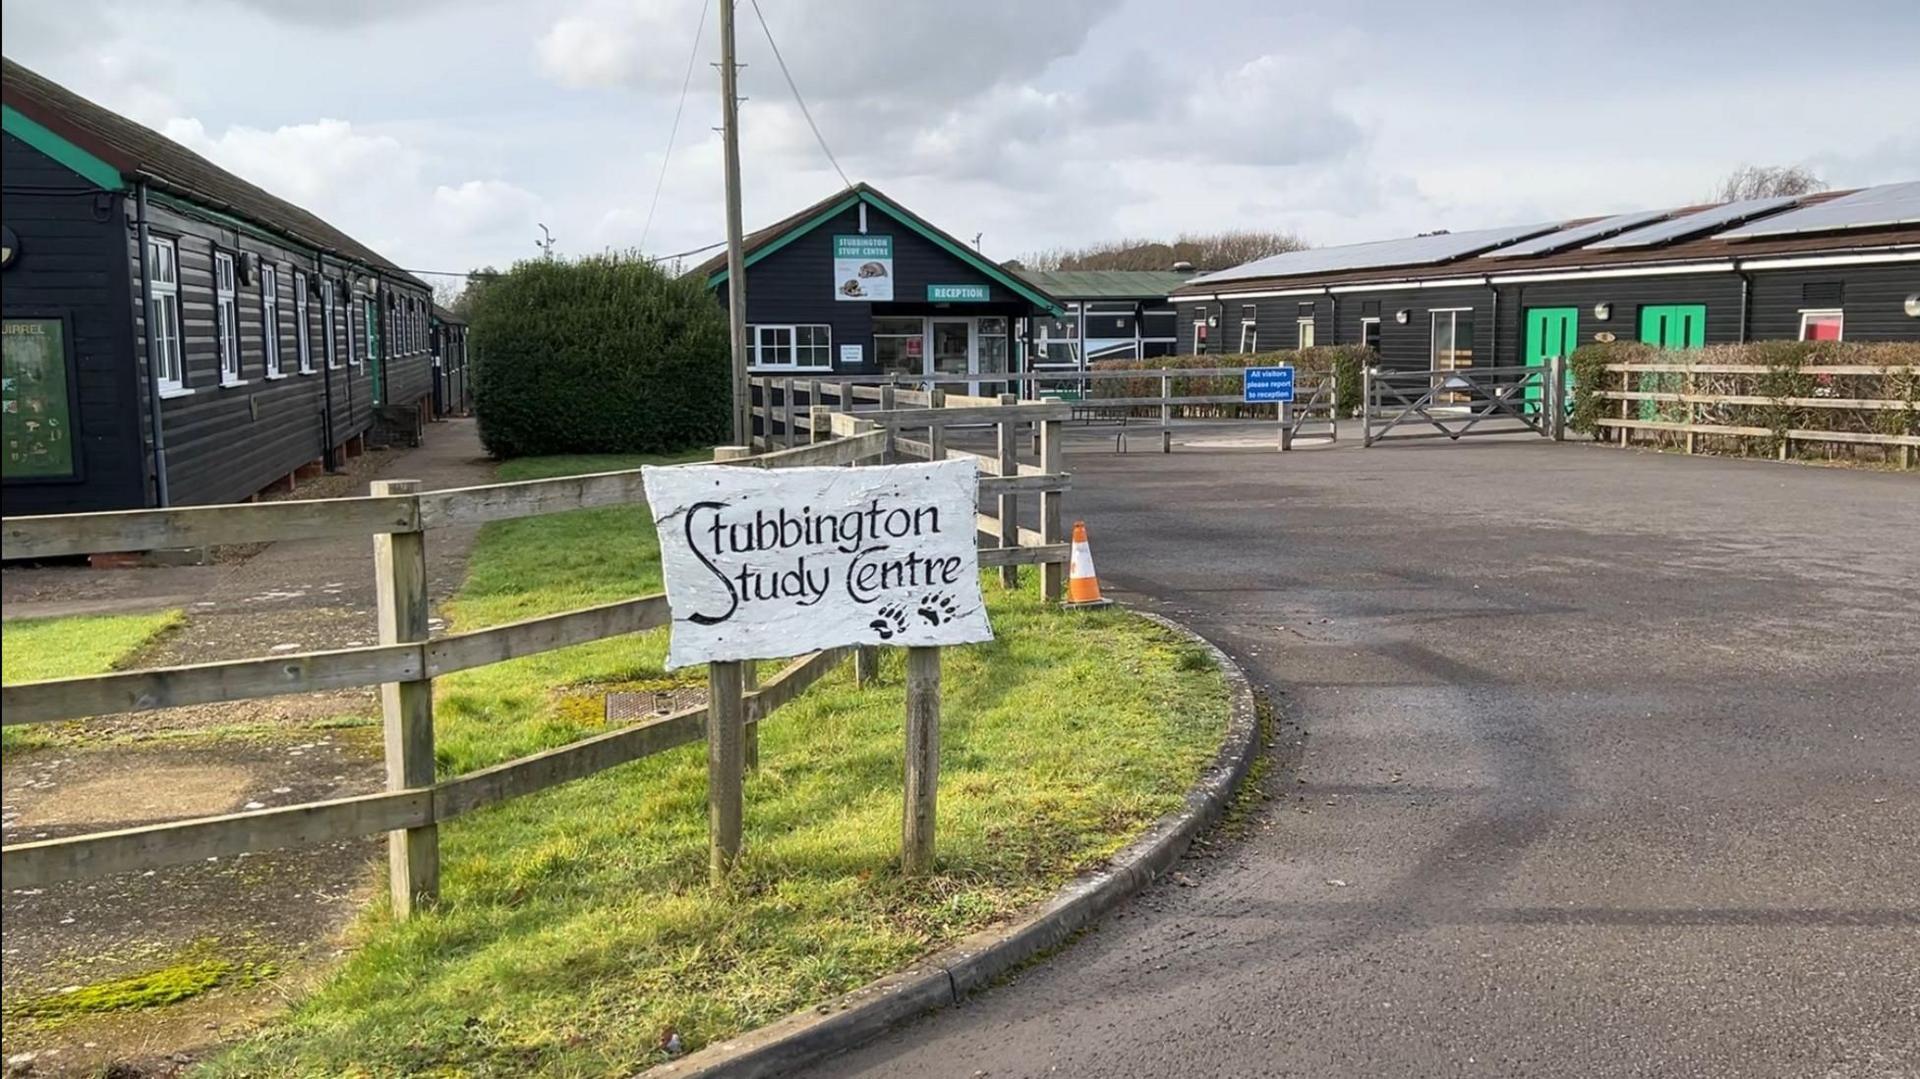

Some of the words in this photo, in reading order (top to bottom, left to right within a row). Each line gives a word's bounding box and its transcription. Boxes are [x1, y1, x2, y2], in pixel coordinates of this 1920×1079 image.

[839, 238, 888, 247] STUBBINGTON
[838, 247, 860, 256] STUDY
[862, 247, 889, 256] CENTRE
[935, 287, 983, 298] RECEPTION
[1247, 381, 1269, 389] please
[1270, 380, 1291, 389] report
[1249, 391, 1256, 399] to
[685, 498, 941, 566] Stubbington
[687, 556, 830, 626] Study
[846, 545, 961, 604] Centre
